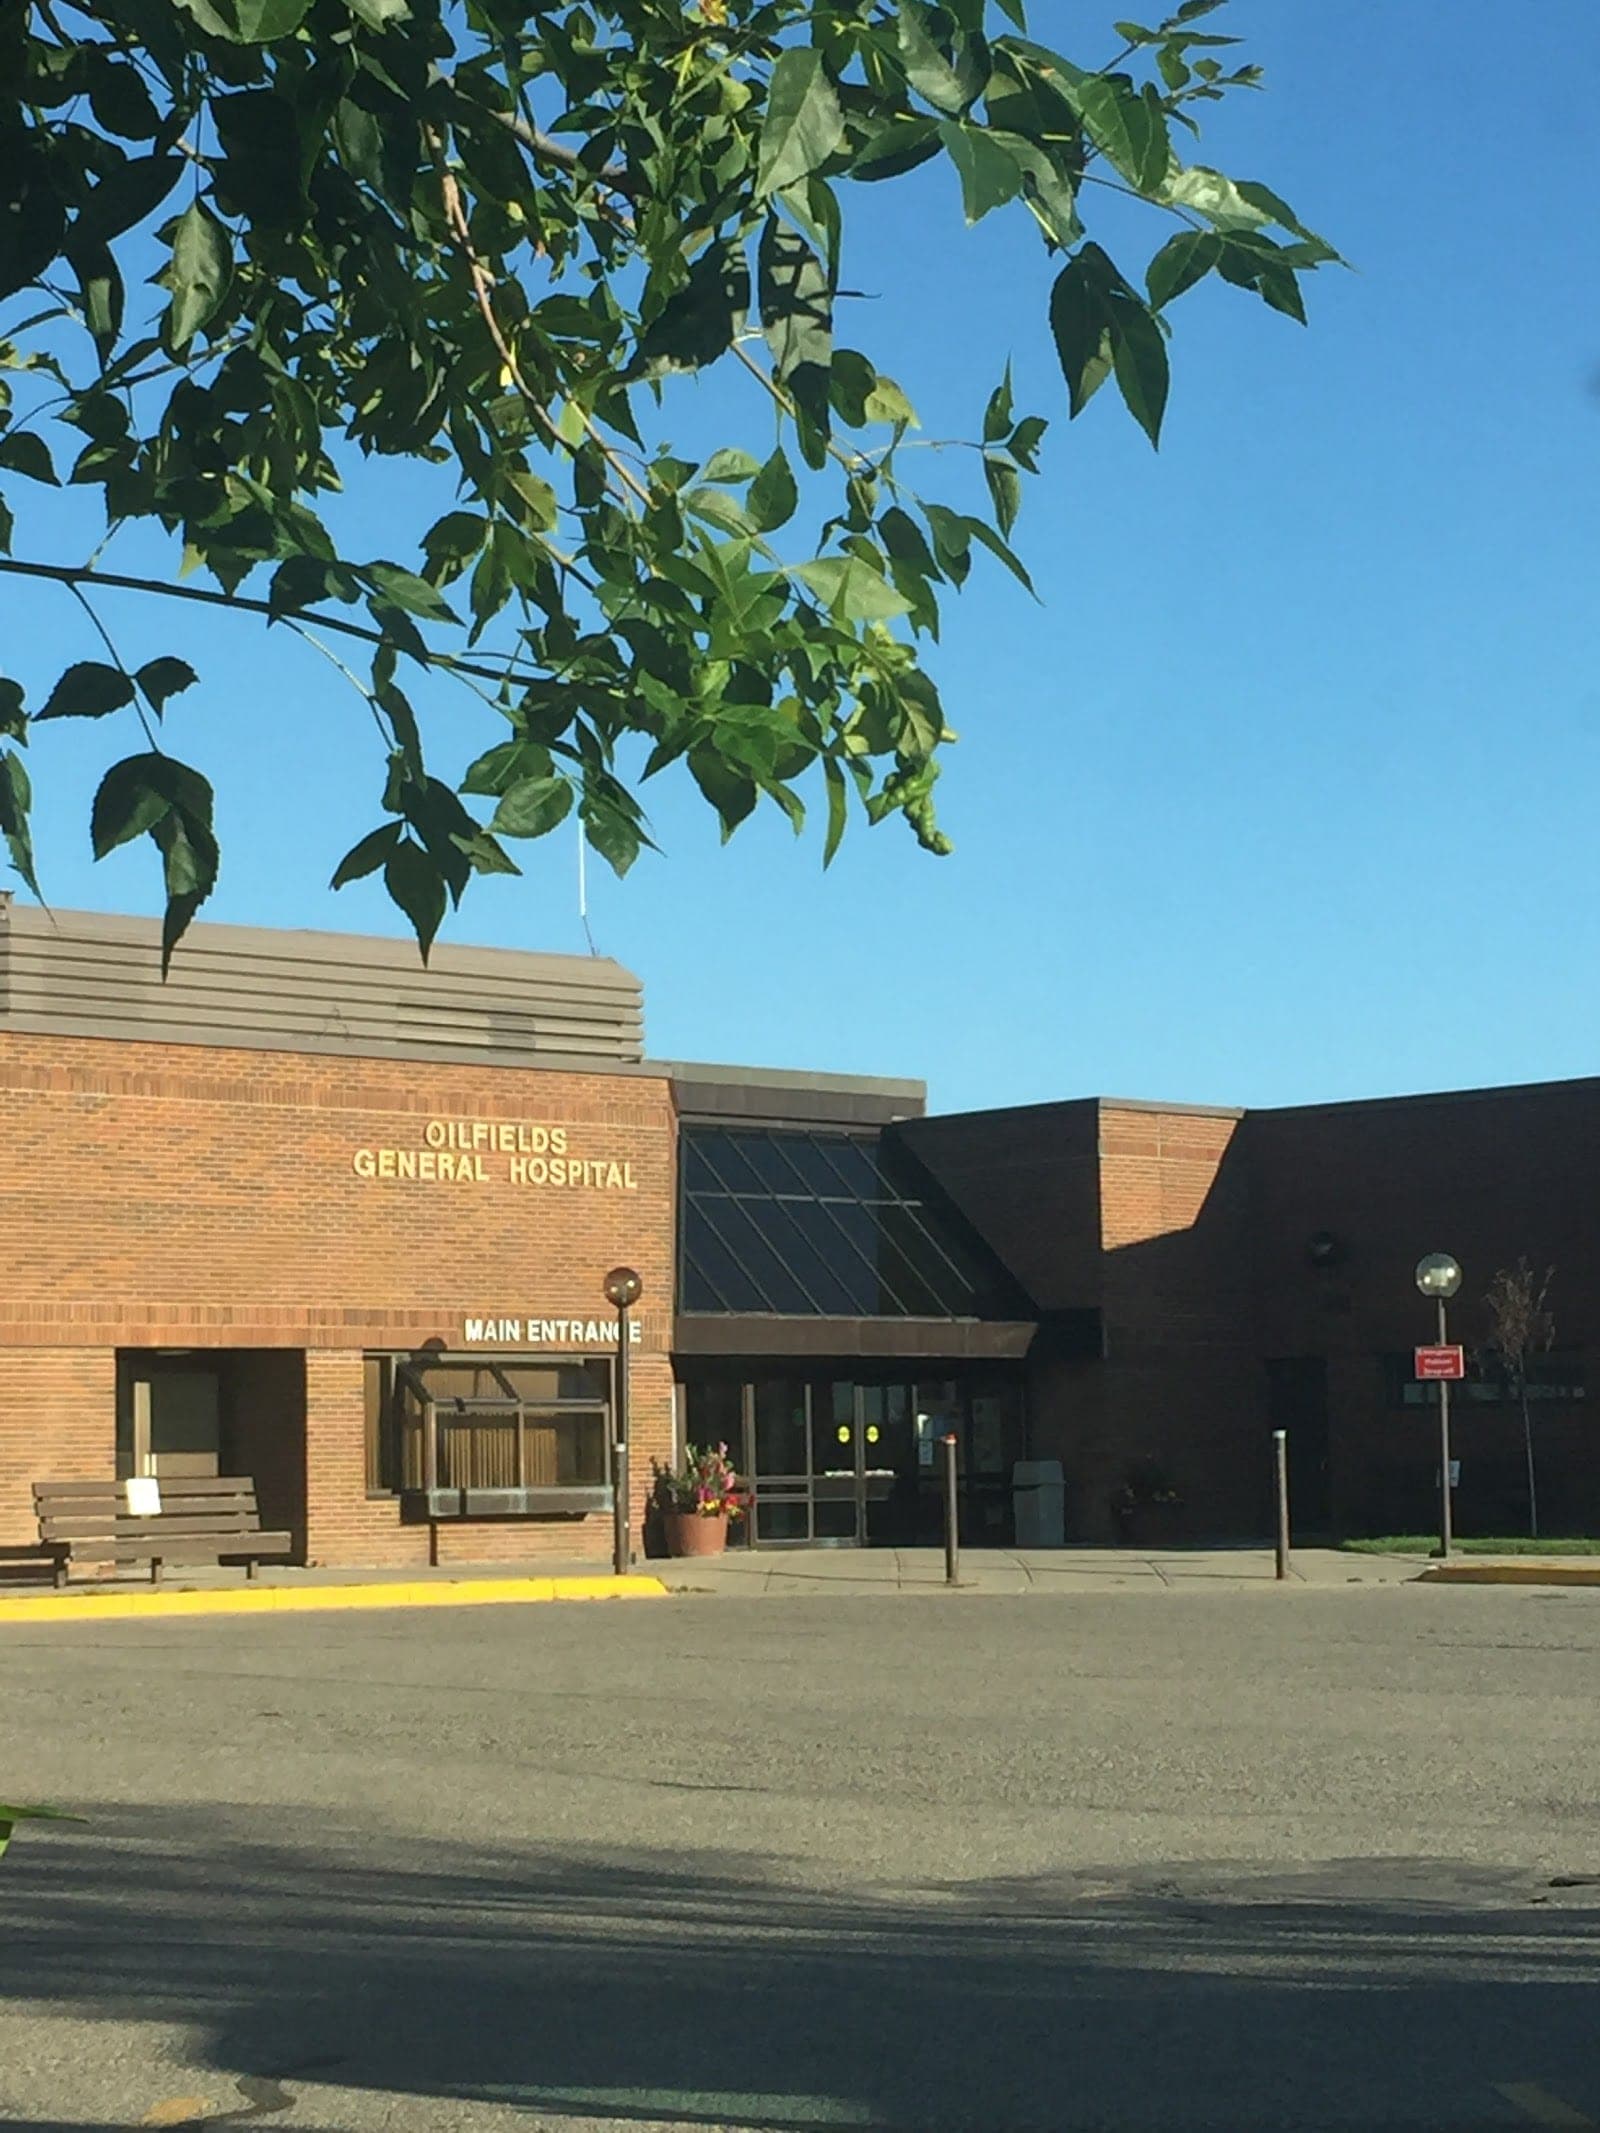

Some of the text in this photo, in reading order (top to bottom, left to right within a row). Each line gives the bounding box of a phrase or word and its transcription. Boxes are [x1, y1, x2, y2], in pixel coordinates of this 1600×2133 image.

[425, 1121, 568, 1153] OILFIELDS
[353, 1149, 638, 1189] GENERAL HOSPITAL
[464, 1319, 520, 1342] MAIN
